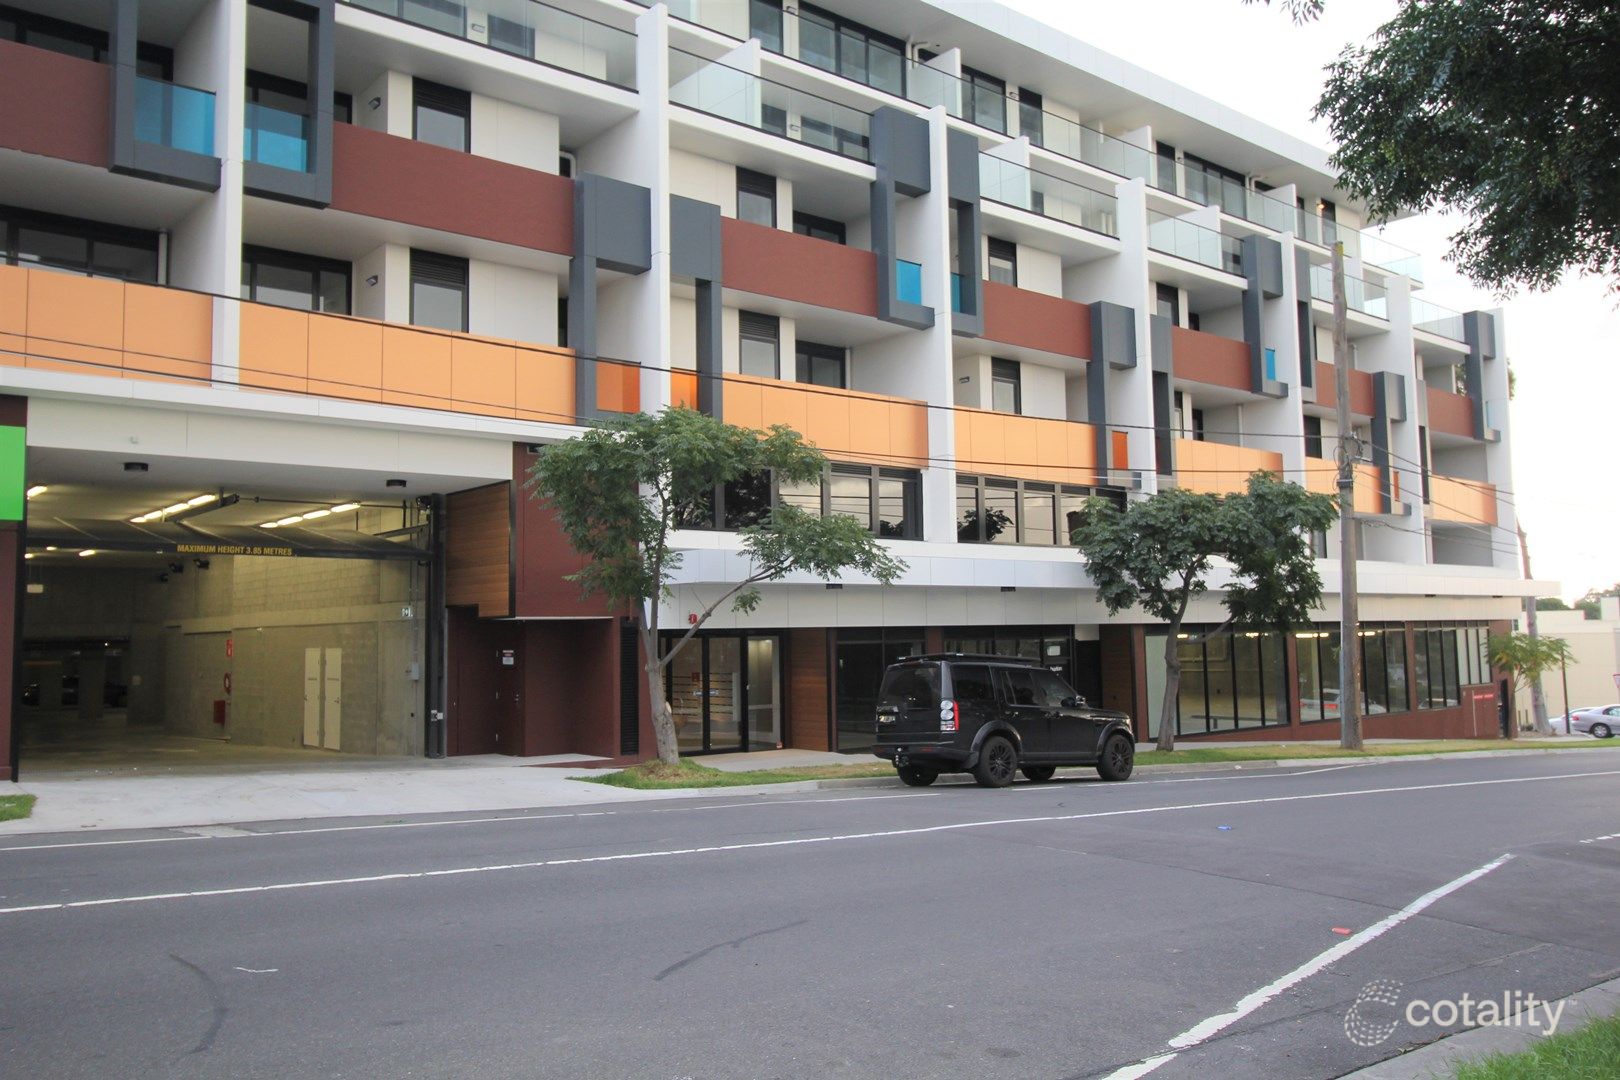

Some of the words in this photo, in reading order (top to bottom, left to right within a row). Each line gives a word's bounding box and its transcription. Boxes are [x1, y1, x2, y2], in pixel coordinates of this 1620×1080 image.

[177, 544, 216, 553] MAXIMUM
[217, 545, 245, 554] HEIGHT
[263, 547, 293, 556] METRES
